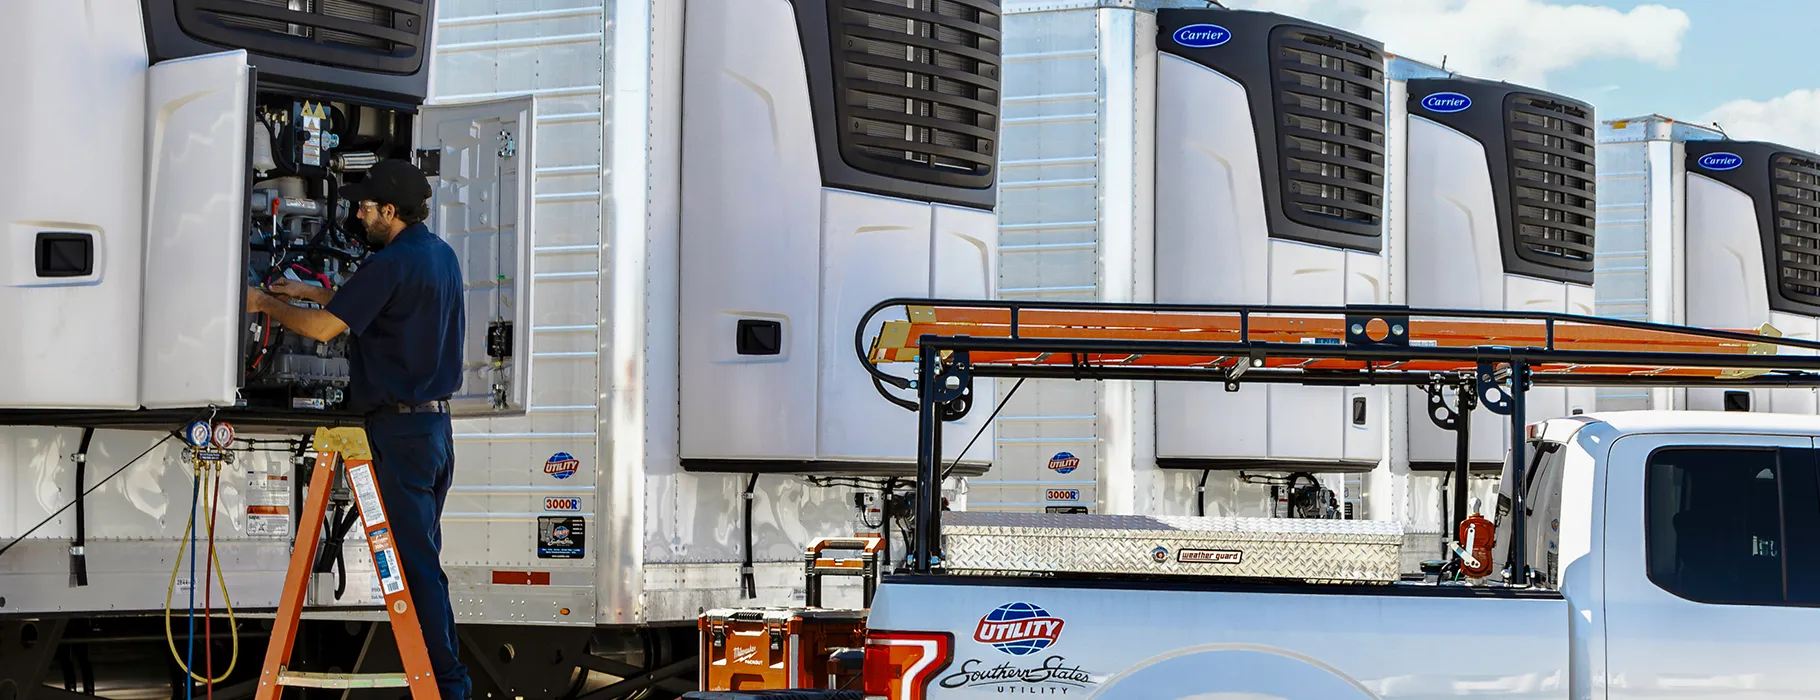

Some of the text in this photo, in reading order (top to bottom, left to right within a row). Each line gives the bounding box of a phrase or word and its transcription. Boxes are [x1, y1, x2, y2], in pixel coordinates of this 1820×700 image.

[1180, 30, 1224, 41] Carrier
[1428, 97, 1465, 106] Carrier
[1704, 157, 1737, 165] Carrier
[546, 461, 577, 472] UTILITY
[1049, 459, 1078, 469] UTILITY
[1182, 551, 1239, 561] weather guard
[979, 620, 1060, 641] UTILITY
[938, 655, 1098, 689] Southern States
[997, 686, 1068, 695] UTILITY
